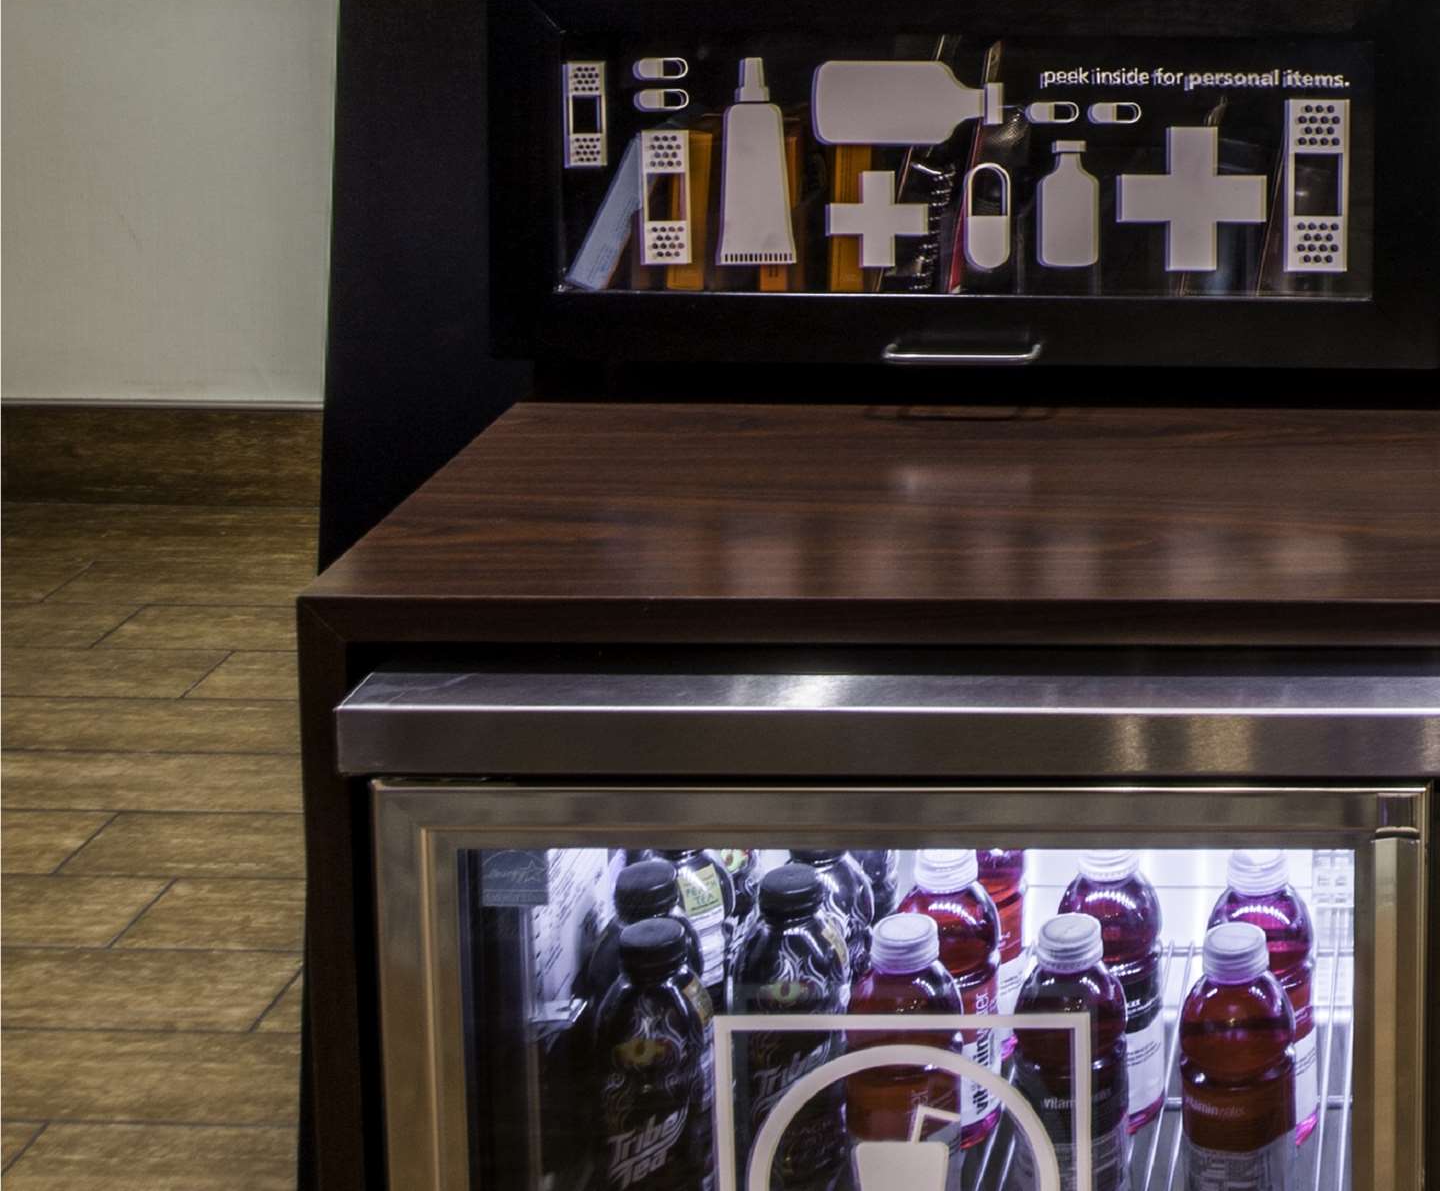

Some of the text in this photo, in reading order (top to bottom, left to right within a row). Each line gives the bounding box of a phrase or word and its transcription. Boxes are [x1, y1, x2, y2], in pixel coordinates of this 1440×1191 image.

[1042, 67, 1350, 90] peek inside for personal items.
[607, 1109, 681, 1159] Tribe
